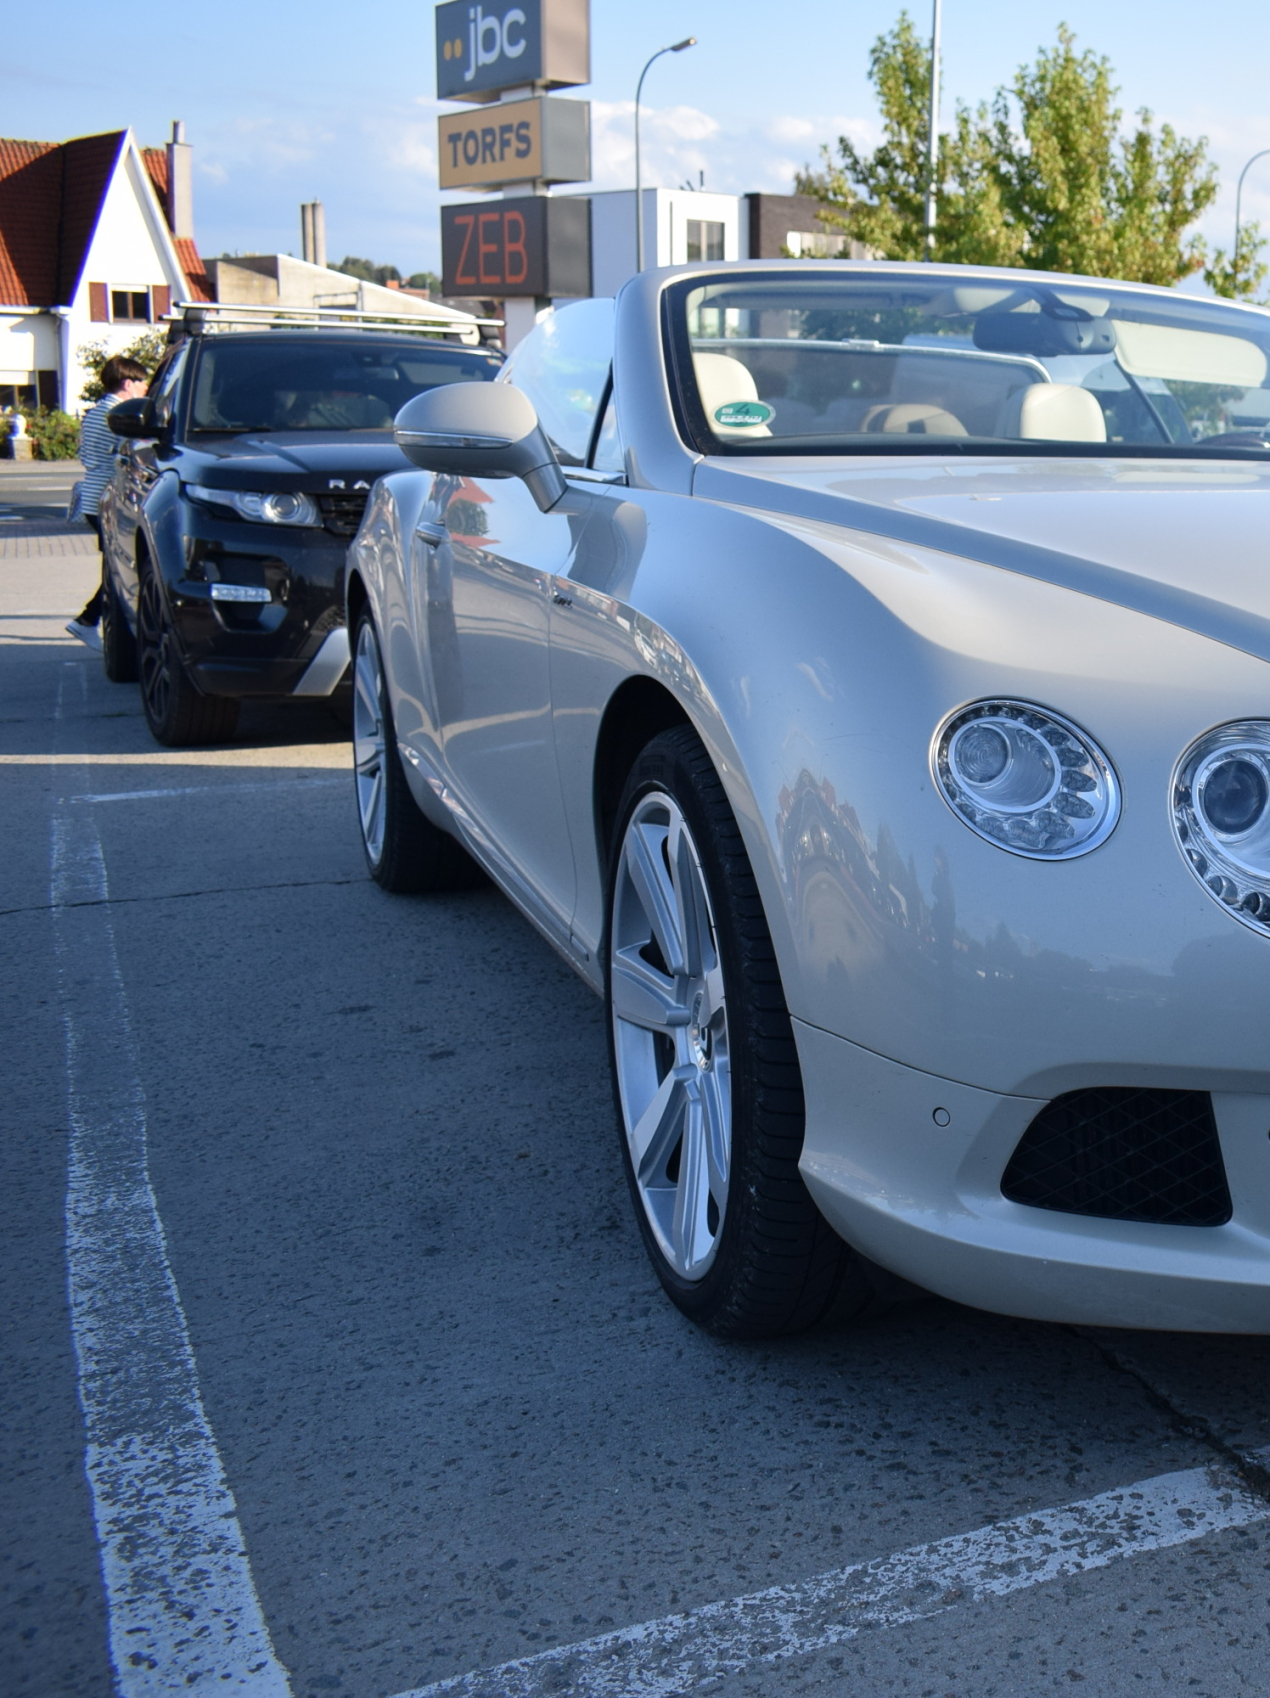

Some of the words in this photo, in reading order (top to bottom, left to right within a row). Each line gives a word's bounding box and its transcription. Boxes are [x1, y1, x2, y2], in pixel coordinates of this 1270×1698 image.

[464, 5, 527, 82] jbc
[447, 121, 532, 168] TORFS
[453, 210, 529, 286] ZEB
[735, 403, 751, 416] 4
[328, 479, 371, 489] RA
